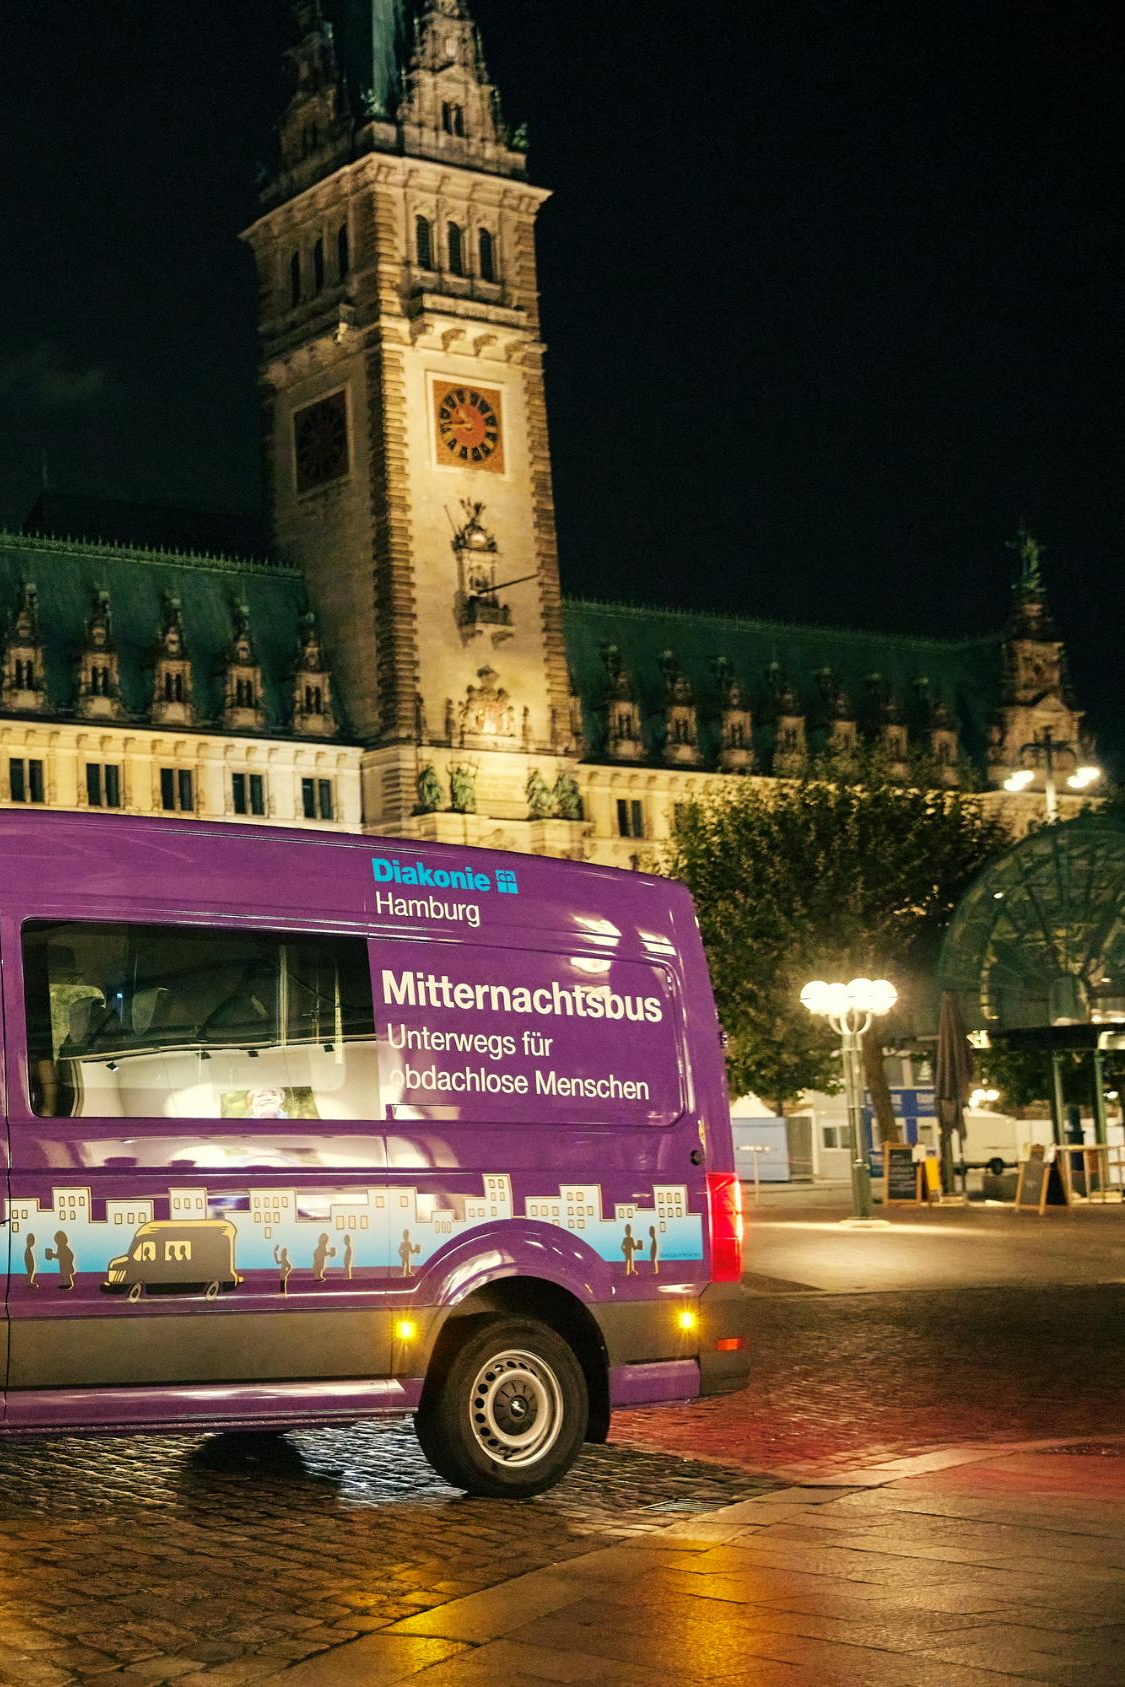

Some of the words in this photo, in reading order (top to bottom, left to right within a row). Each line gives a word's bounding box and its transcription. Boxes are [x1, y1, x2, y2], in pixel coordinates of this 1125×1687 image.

[372, 858, 491, 891] Diakonie
[375, 891, 481, 927] Hamburg
[381, 970, 663, 1022] Mitternachtsbus
[387, 1023, 516, 1061] Unterwegs
[523, 1031, 554, 1057] für
[390, 1064, 528, 1093] obdachlose
[535, 1070, 650, 1100] Menschen
